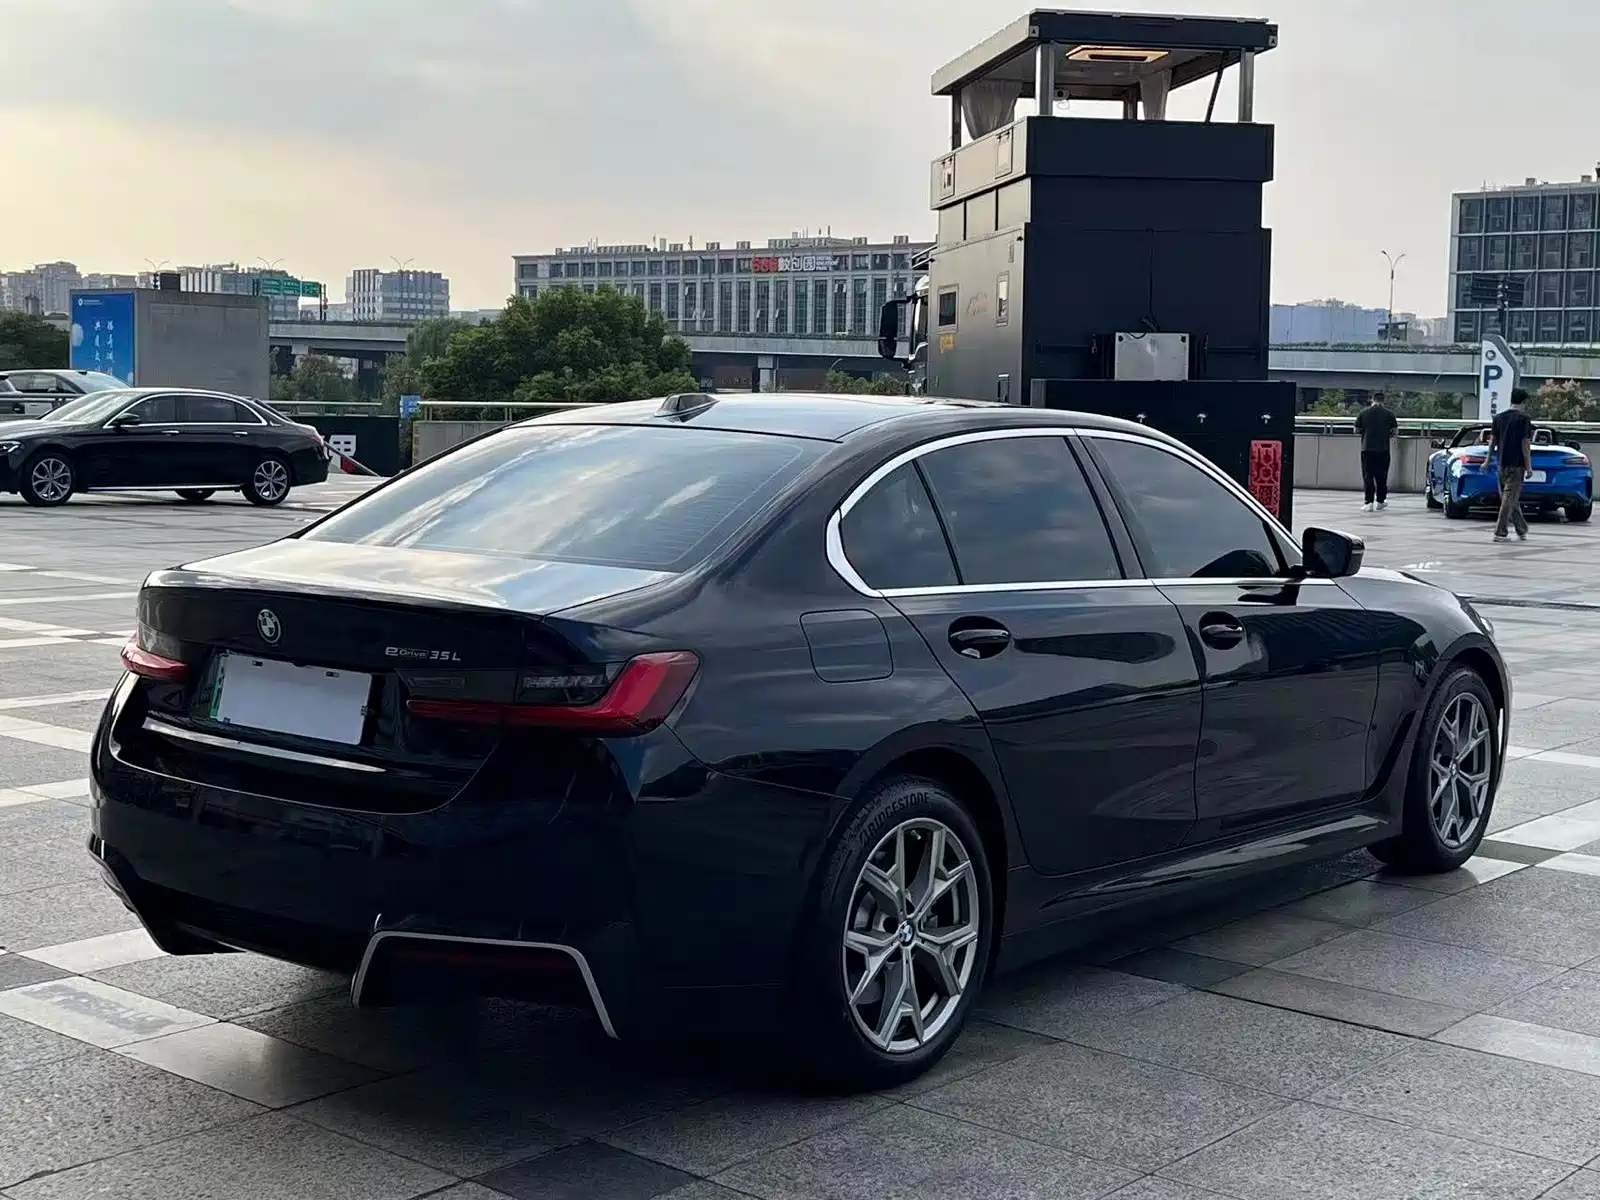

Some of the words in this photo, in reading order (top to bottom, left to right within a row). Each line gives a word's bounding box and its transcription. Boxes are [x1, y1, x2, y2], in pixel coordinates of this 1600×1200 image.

[1484, 365, 1502, 389] P
[429, 650, 461, 661] 35L
[860, 791, 930, 845] BRIDGESTONE
